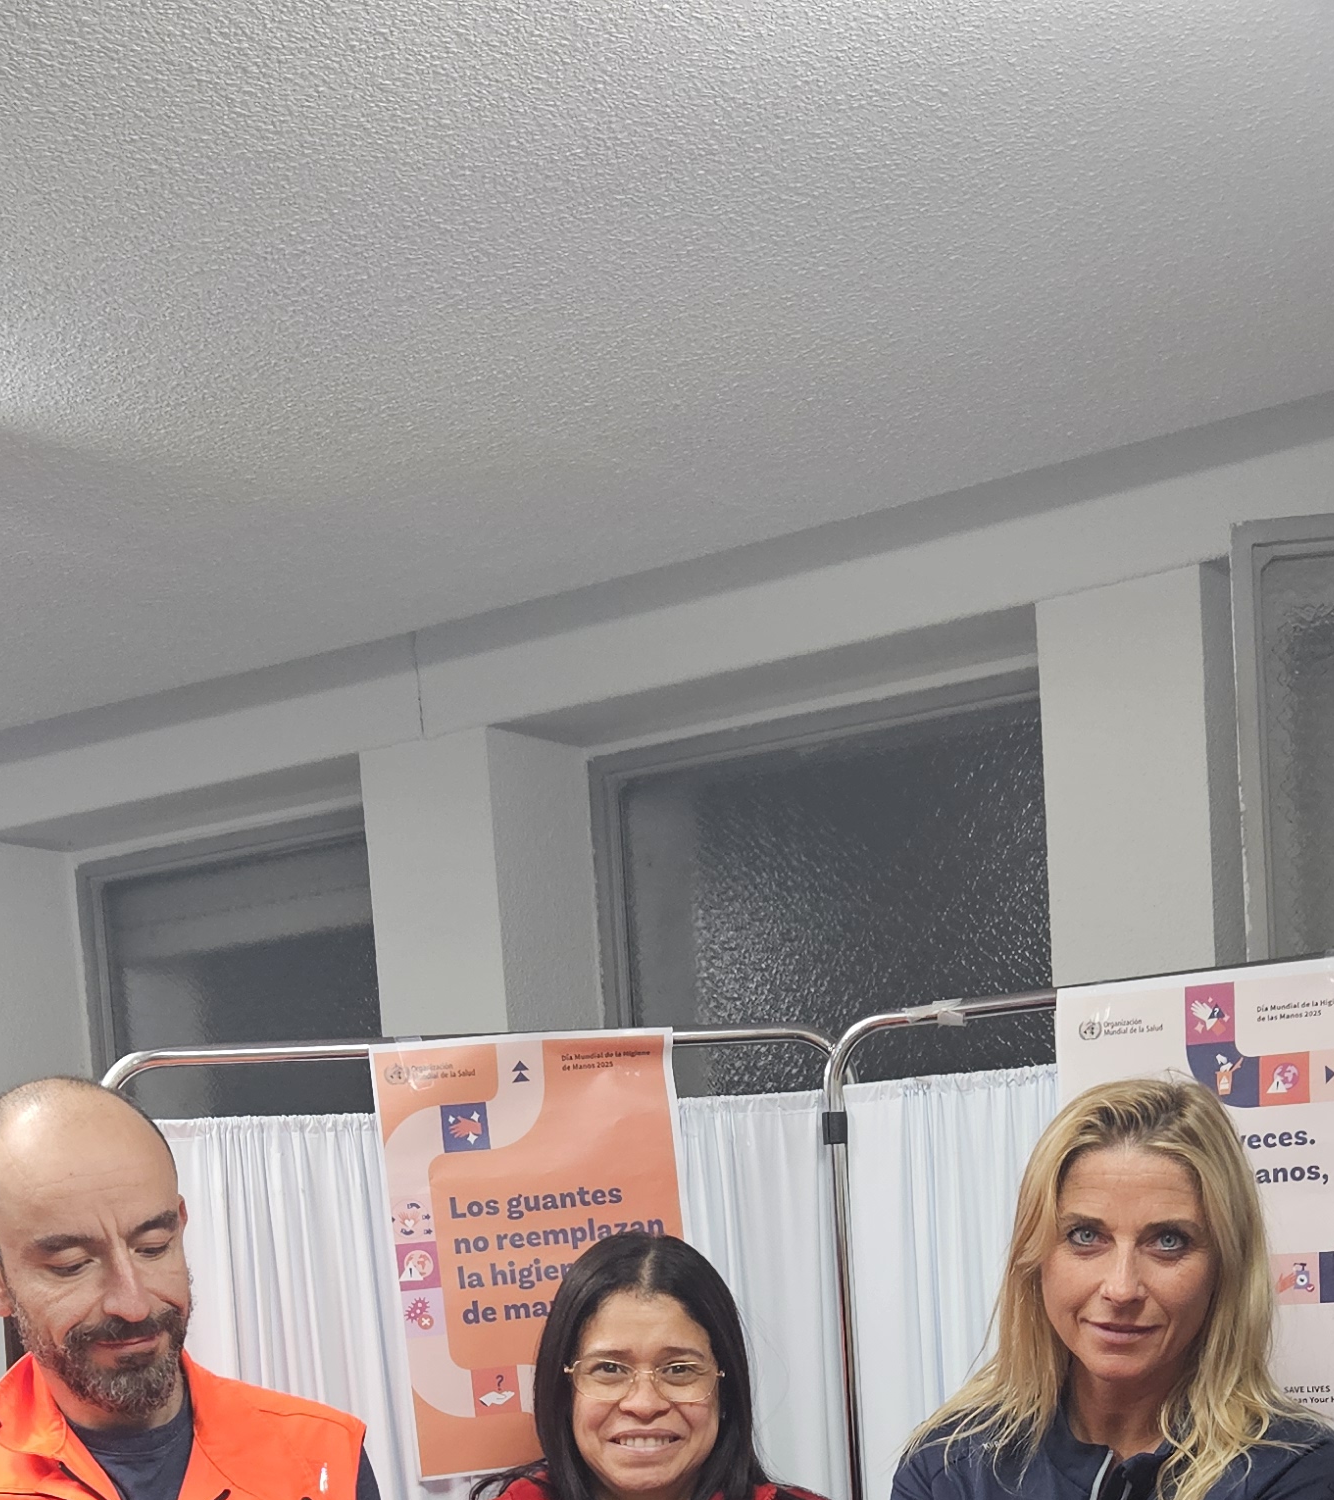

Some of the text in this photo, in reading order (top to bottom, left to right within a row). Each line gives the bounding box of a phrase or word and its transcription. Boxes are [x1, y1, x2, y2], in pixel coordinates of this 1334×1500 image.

[1256, 1004, 1269, 1013] Día
[1270, 1002, 1300, 1011] Mundial
[1267, 1014, 1278, 1022] las
[1279, 1012, 1303, 1020] Manos
[1103, 1018, 1143, 1029] Organización
[1103, 1023, 1164, 1036] Mundial de la Salud
[561, 1053, 574, 1062] Día
[574, 1052, 604, 1061] Mundial
[440, 1071, 449, 1079] de
[450, 1070, 457, 1078] la
[457, 1068, 476, 1078] Salud
[1255, 1164, 1329, 1185] anos,
[449, 1186, 623, 1220] Los guantes
[453, 1234, 490, 1254] no
[457, 1265, 485, 1290] la
[462, 1300, 498, 1325] de
[1283, 1385, 1331, 1394] SAVE LIVES
[1309, 1396, 1329, 1404] Your
